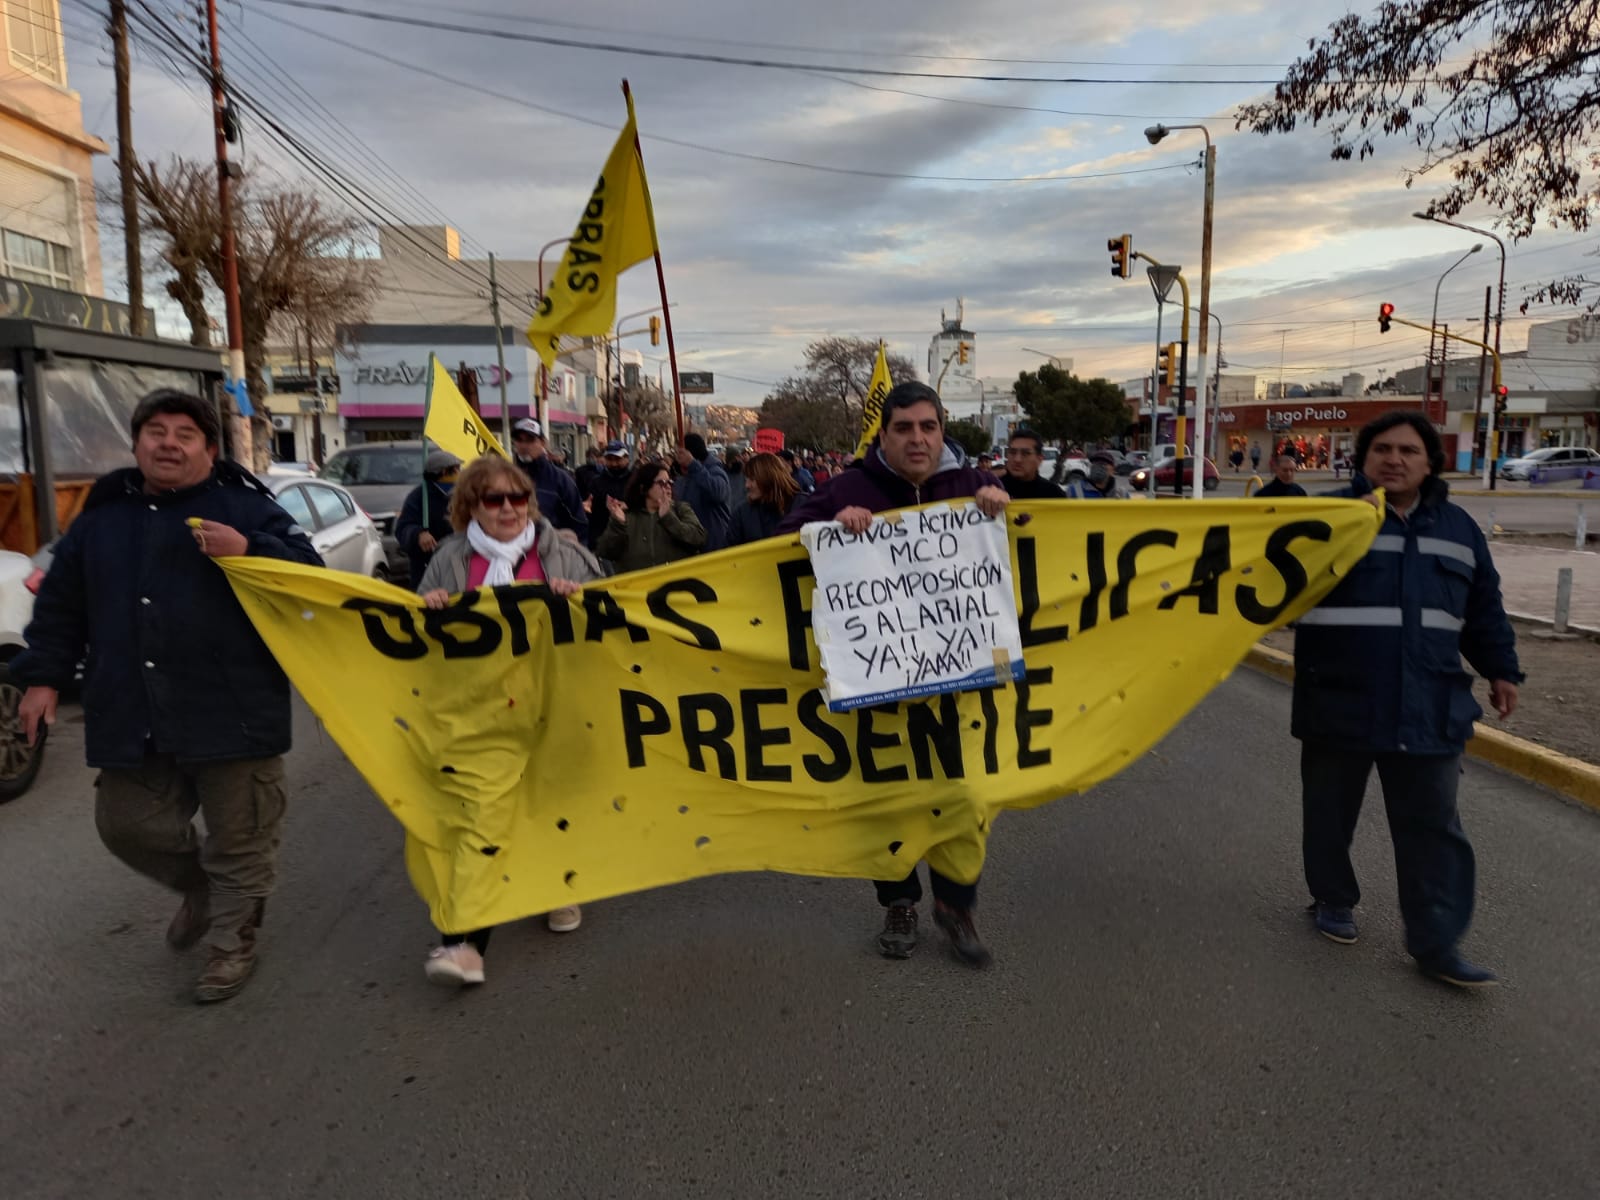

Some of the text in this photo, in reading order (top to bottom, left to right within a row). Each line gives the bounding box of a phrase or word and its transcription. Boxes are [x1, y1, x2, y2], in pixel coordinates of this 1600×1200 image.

[1304, 406, 1347, 421] Puelo
[777, 519, 1332, 672] PLICAS
[825, 555, 1002, 613] RECOMPOSICIÓN
[844, 591, 1000, 642] SALARIAL
[853, 621, 997, 679] YA!! YA!!
[618, 666, 1053, 784] PRESENTE
